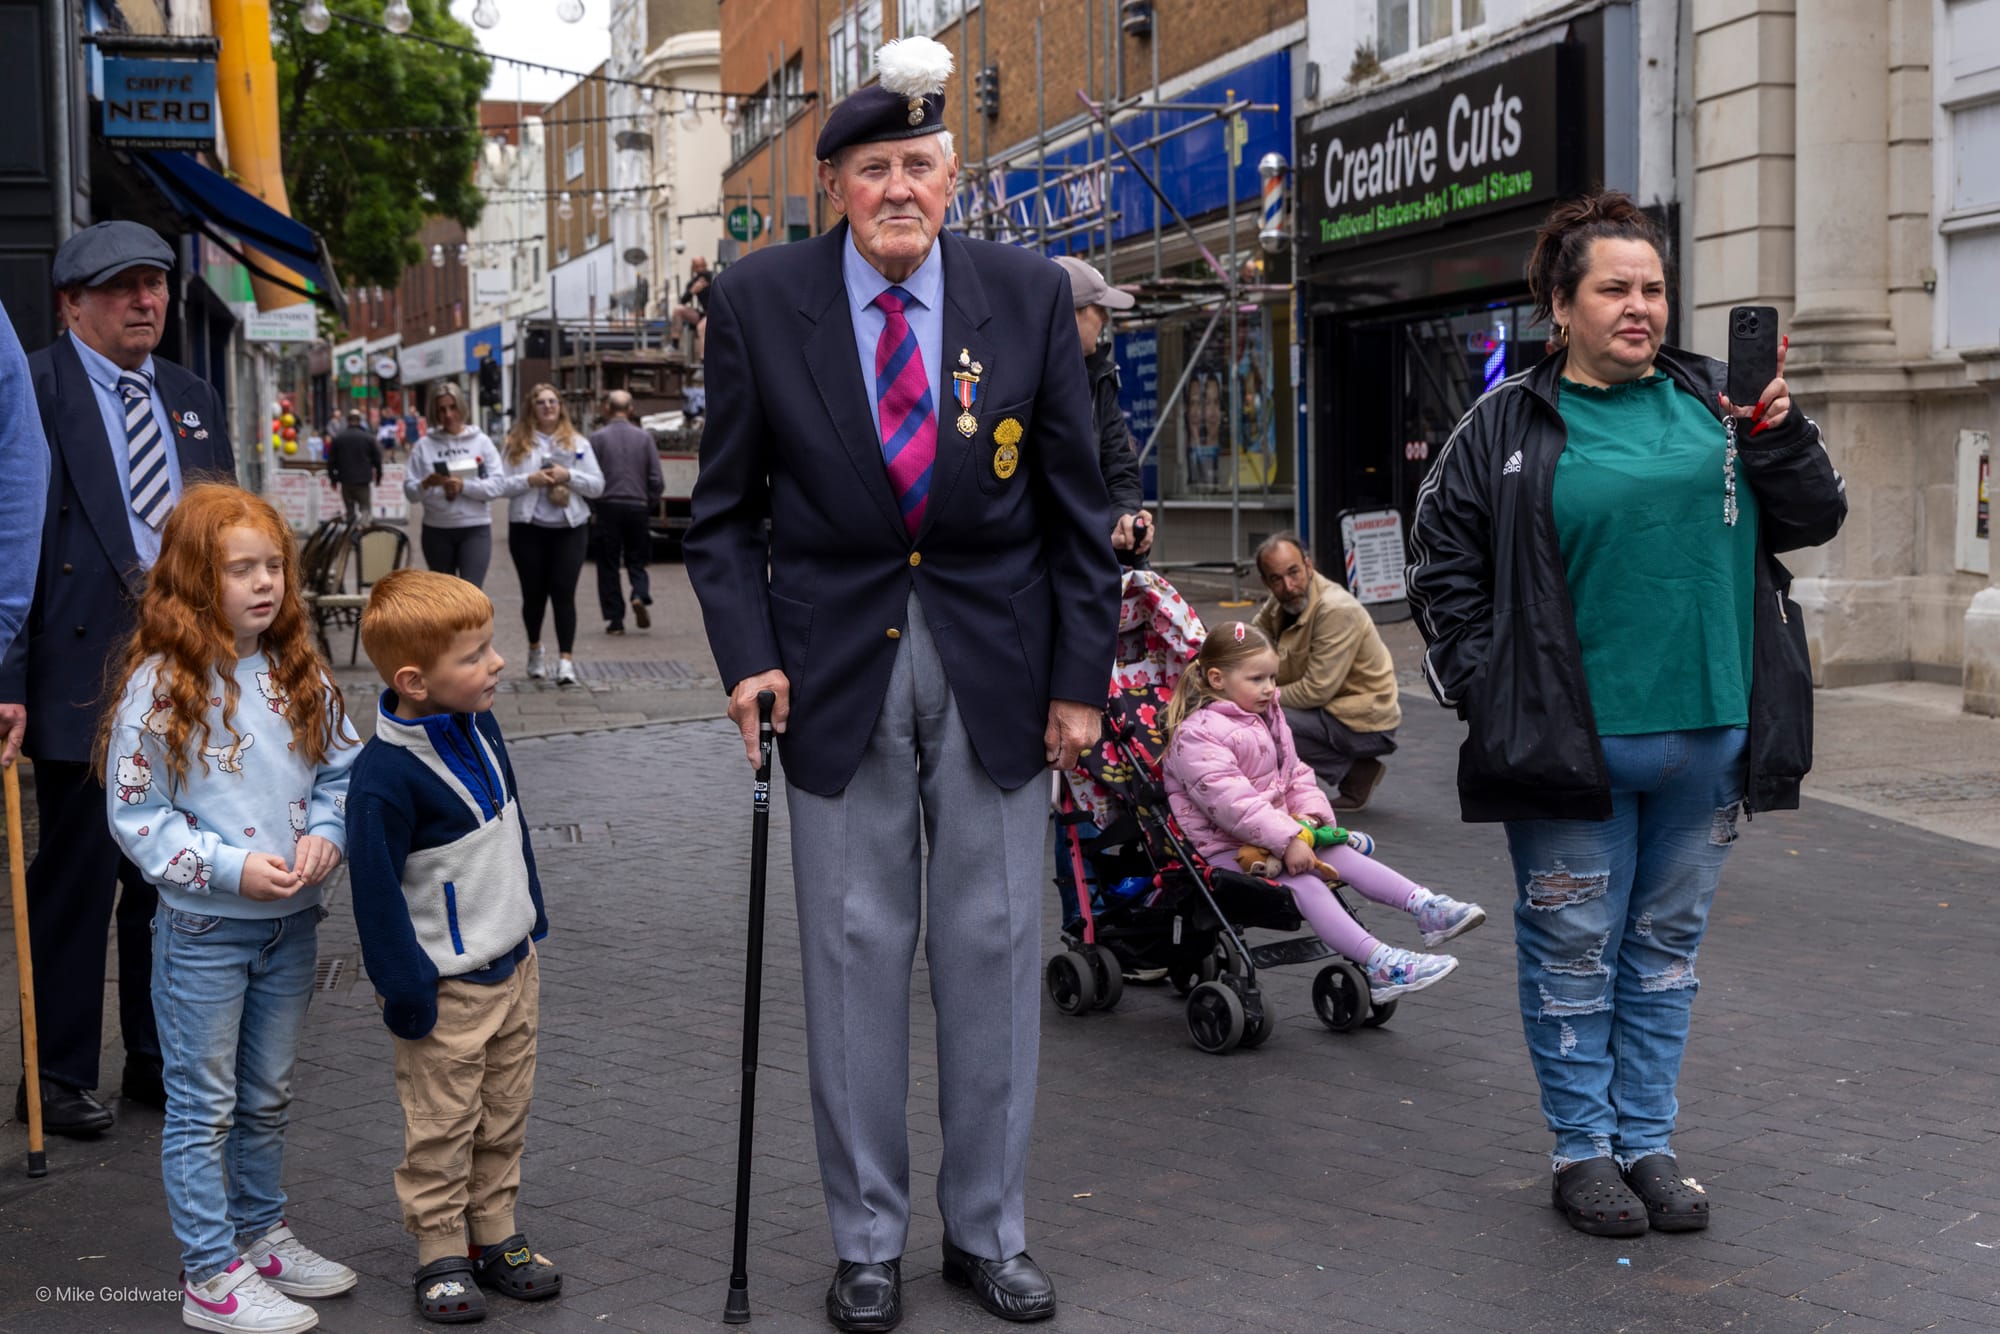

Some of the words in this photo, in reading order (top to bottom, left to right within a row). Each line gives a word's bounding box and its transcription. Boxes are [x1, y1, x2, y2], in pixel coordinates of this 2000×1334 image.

[108, 100, 210, 121] NERO
[1324, 118, 1438, 208] Creative
[1447, 84, 1523, 172] Cuts
[1320, 207, 1376, 243] Traditional
[1449, 175, 1488, 211] Towel
[1490, 169, 1533, 201] Shave
[1354, 517, 1397, 531] BARBERSHOP
